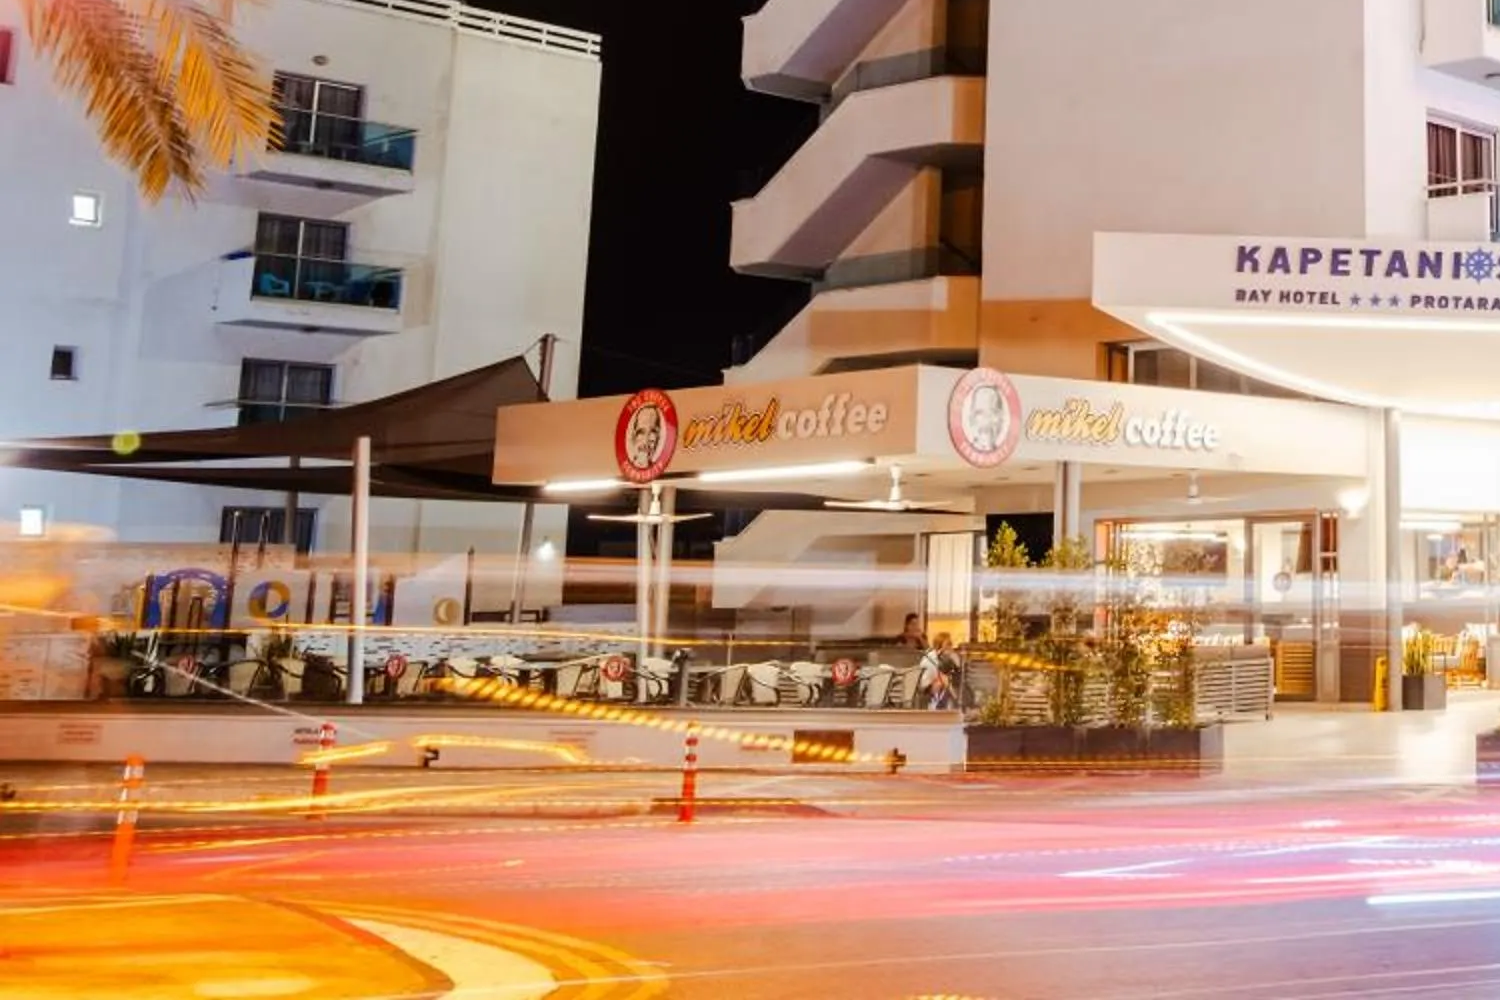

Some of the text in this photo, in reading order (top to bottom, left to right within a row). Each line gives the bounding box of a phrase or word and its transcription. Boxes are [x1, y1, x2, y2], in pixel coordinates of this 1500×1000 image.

[1235, 289, 1272, 304] BAY
[1279, 291, 1341, 306] HOTEL
[683, 396, 780, 449] mikel
[778, 392, 888, 440] coffee
[1026, 395, 1222, 451] mikel coffee
